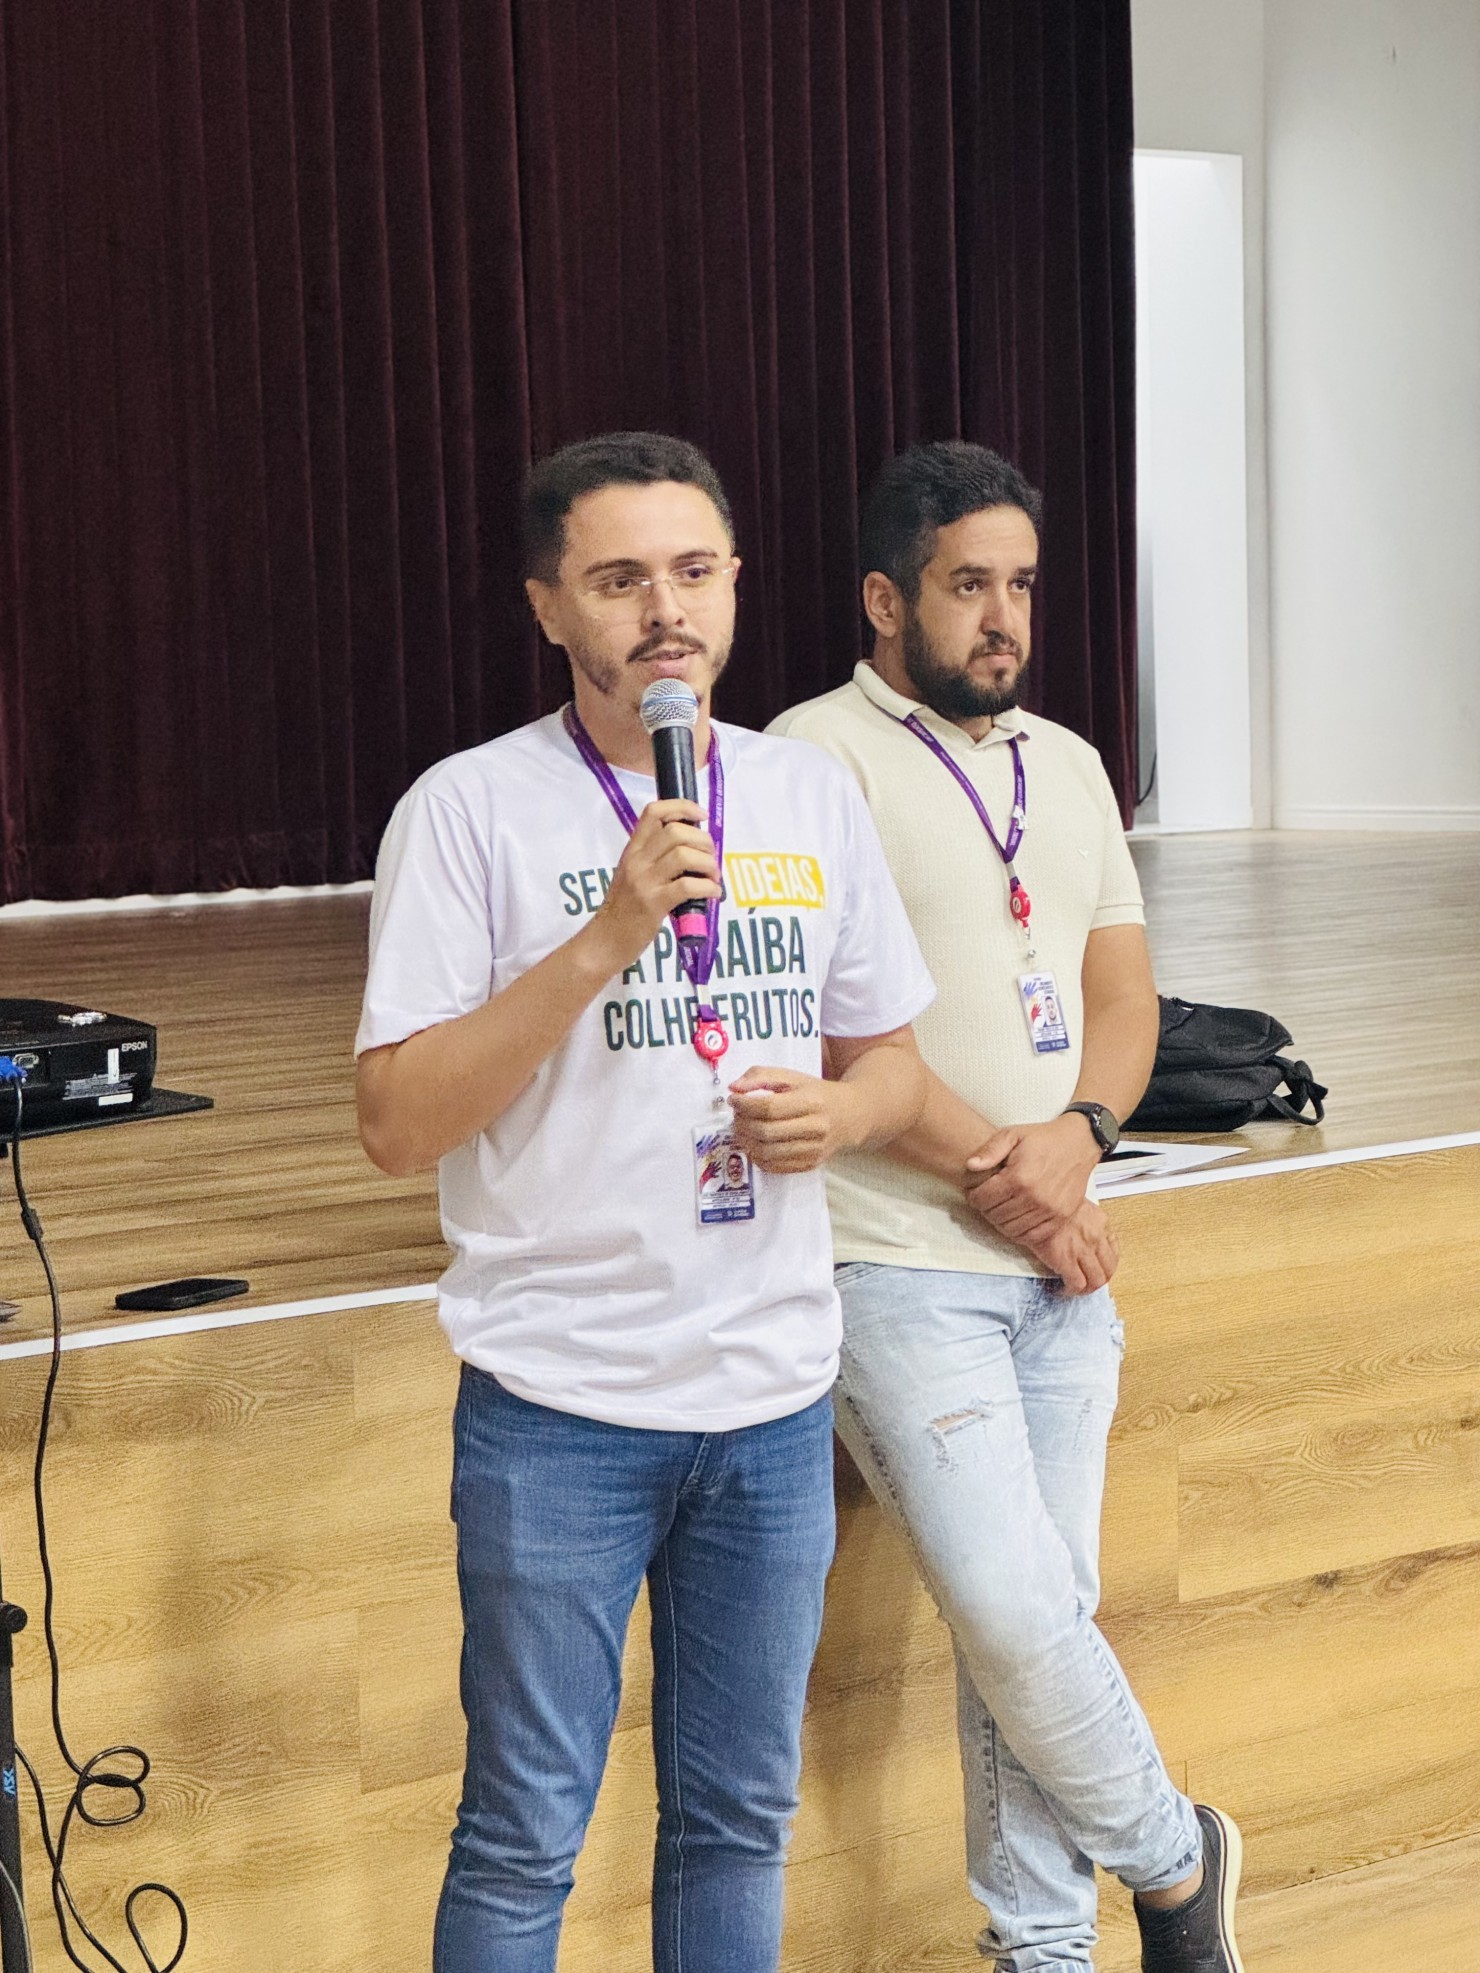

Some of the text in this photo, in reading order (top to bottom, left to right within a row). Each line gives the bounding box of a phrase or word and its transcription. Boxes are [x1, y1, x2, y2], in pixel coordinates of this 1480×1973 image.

[653, 907, 806, 984] PAÍBA
[711, 987, 819, 1041] FRUTOS.
[121, 1041, 147, 1052] EPSON
